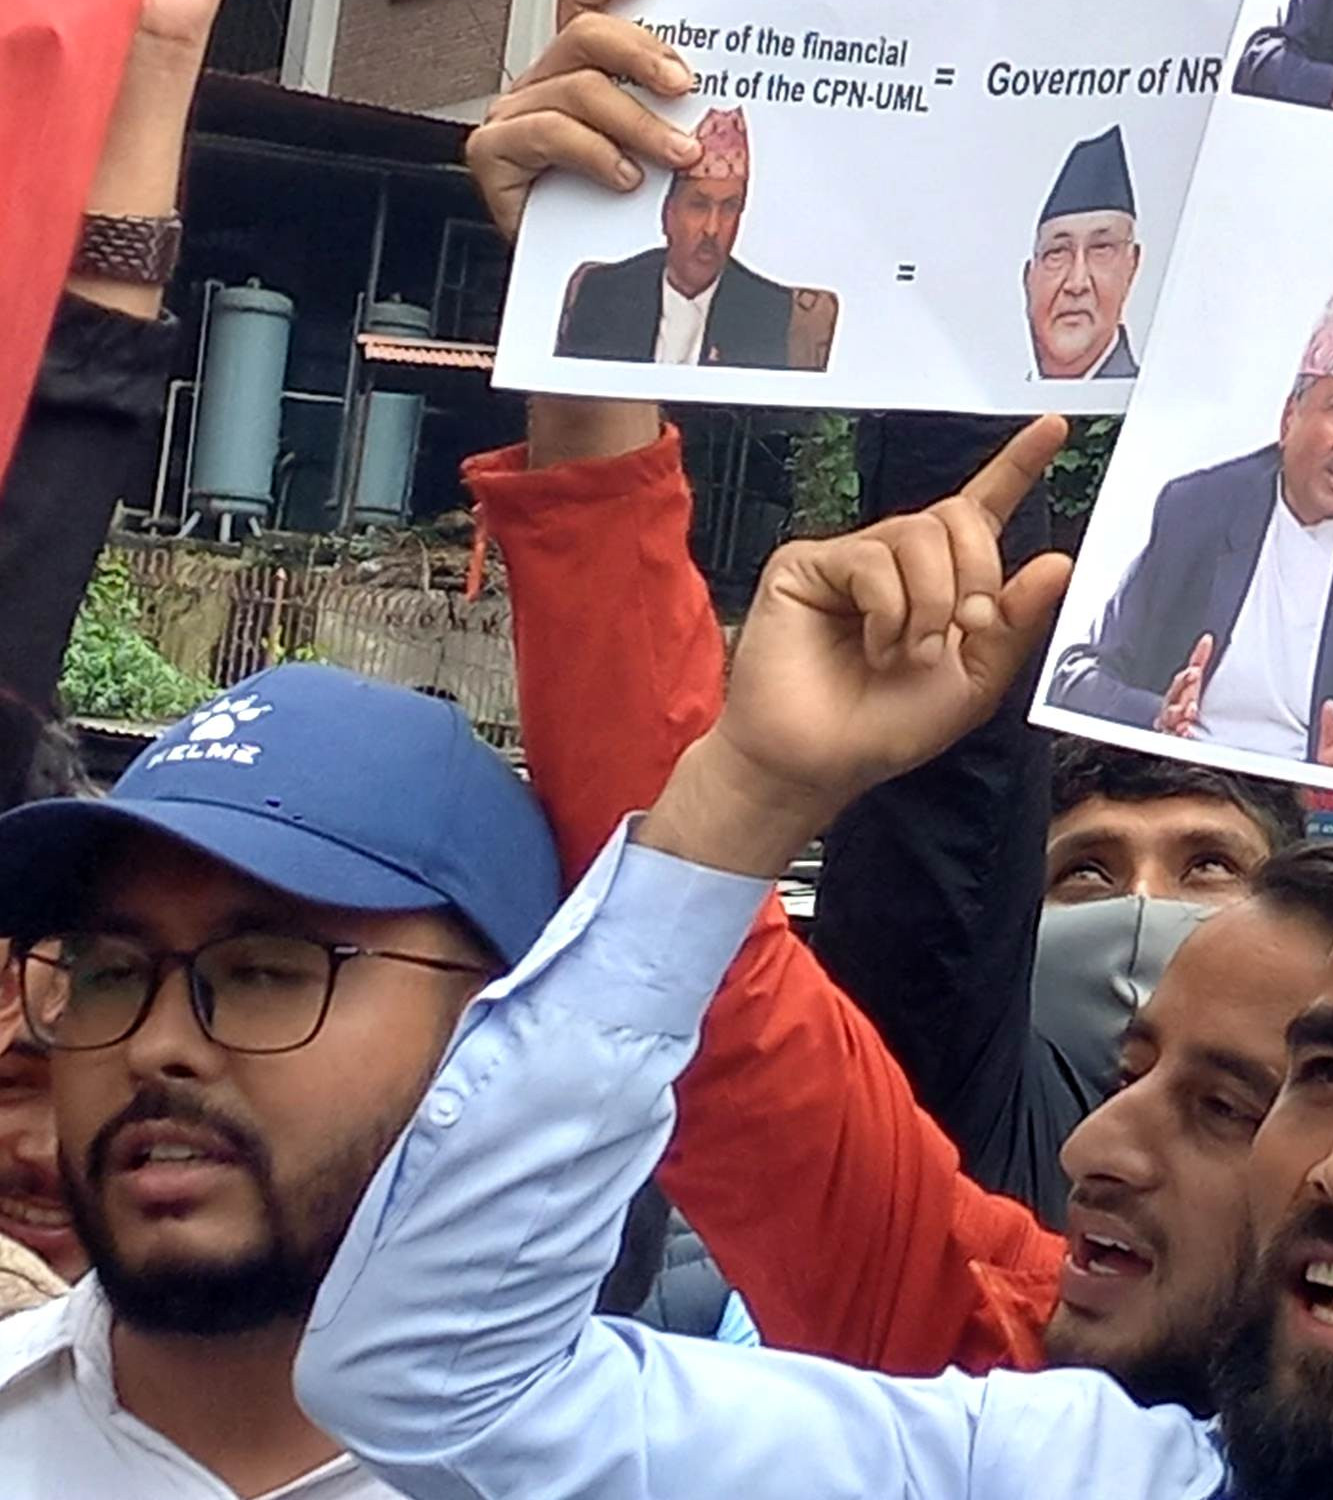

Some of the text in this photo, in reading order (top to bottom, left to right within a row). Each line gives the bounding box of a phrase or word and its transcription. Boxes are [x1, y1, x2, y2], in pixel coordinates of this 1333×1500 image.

[633, 18, 719, 49] mber
[725, 25, 752, 53] of
[757, 28, 795, 57] the
[803, 31, 907, 67] financial
[988, 62, 1131, 96] Governor
[1138, 58, 1172, 95] of
[1178, 56, 1223, 93] NR
[735, 71, 763, 99] of
[767, 74, 805, 102] the
[813, 79, 928, 112] CPN-UML
